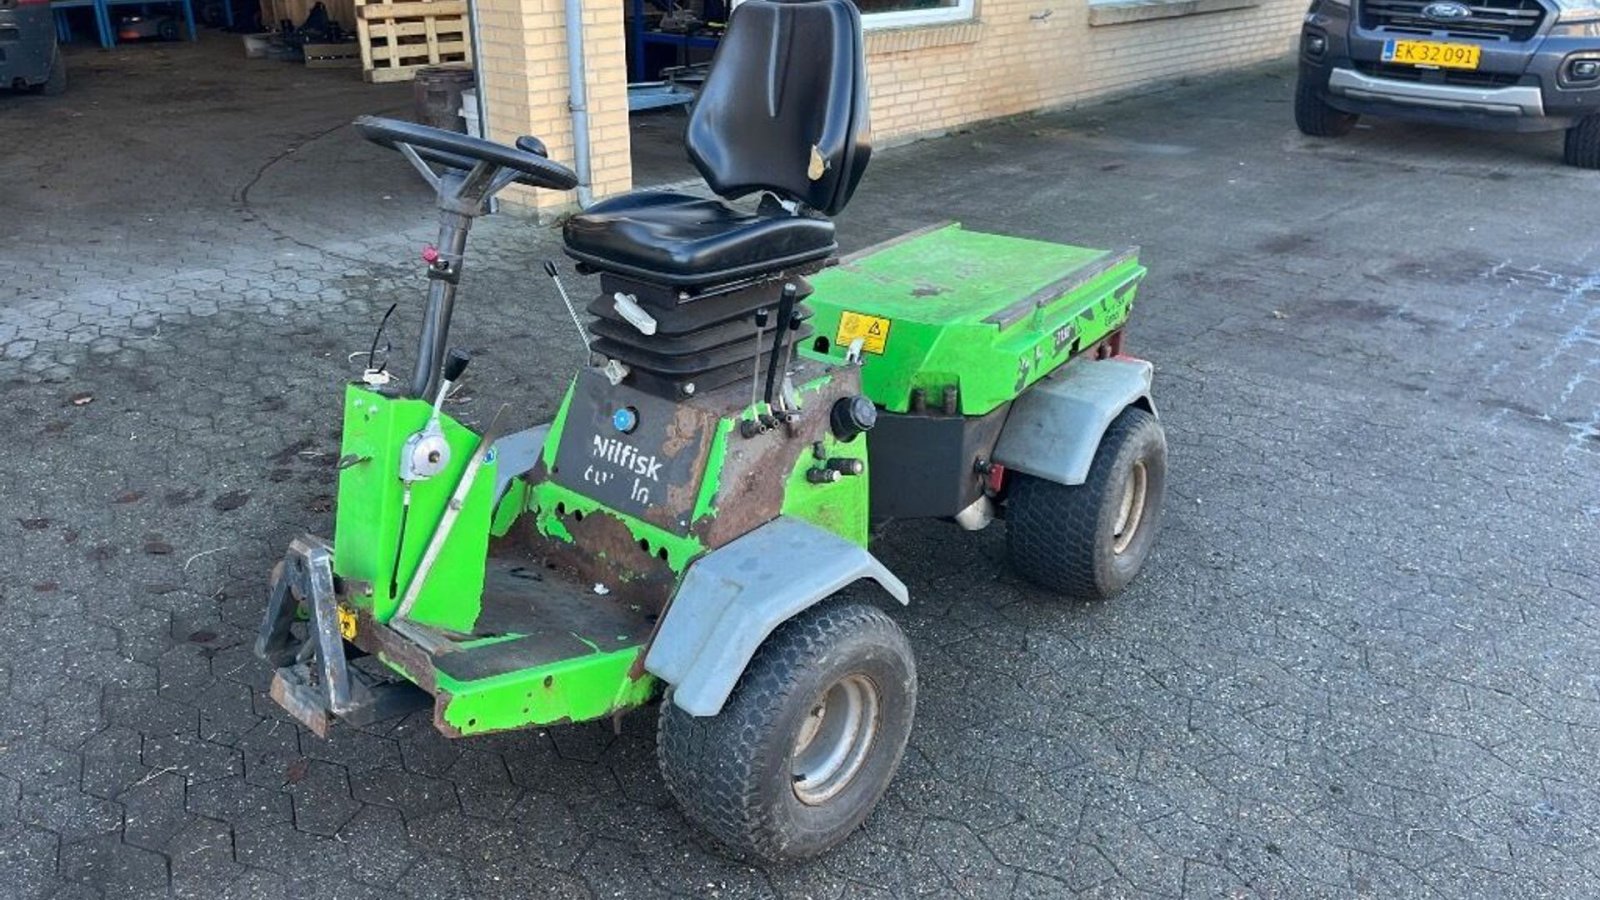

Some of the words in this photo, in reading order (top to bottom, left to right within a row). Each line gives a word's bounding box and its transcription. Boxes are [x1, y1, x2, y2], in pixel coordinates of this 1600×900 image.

[1396, 43, 1416, 60] EK
[1418, 45, 1440, 61] 32
[1443, 47, 1472, 64] 091
[593, 433, 663, 482] Nilfisk
